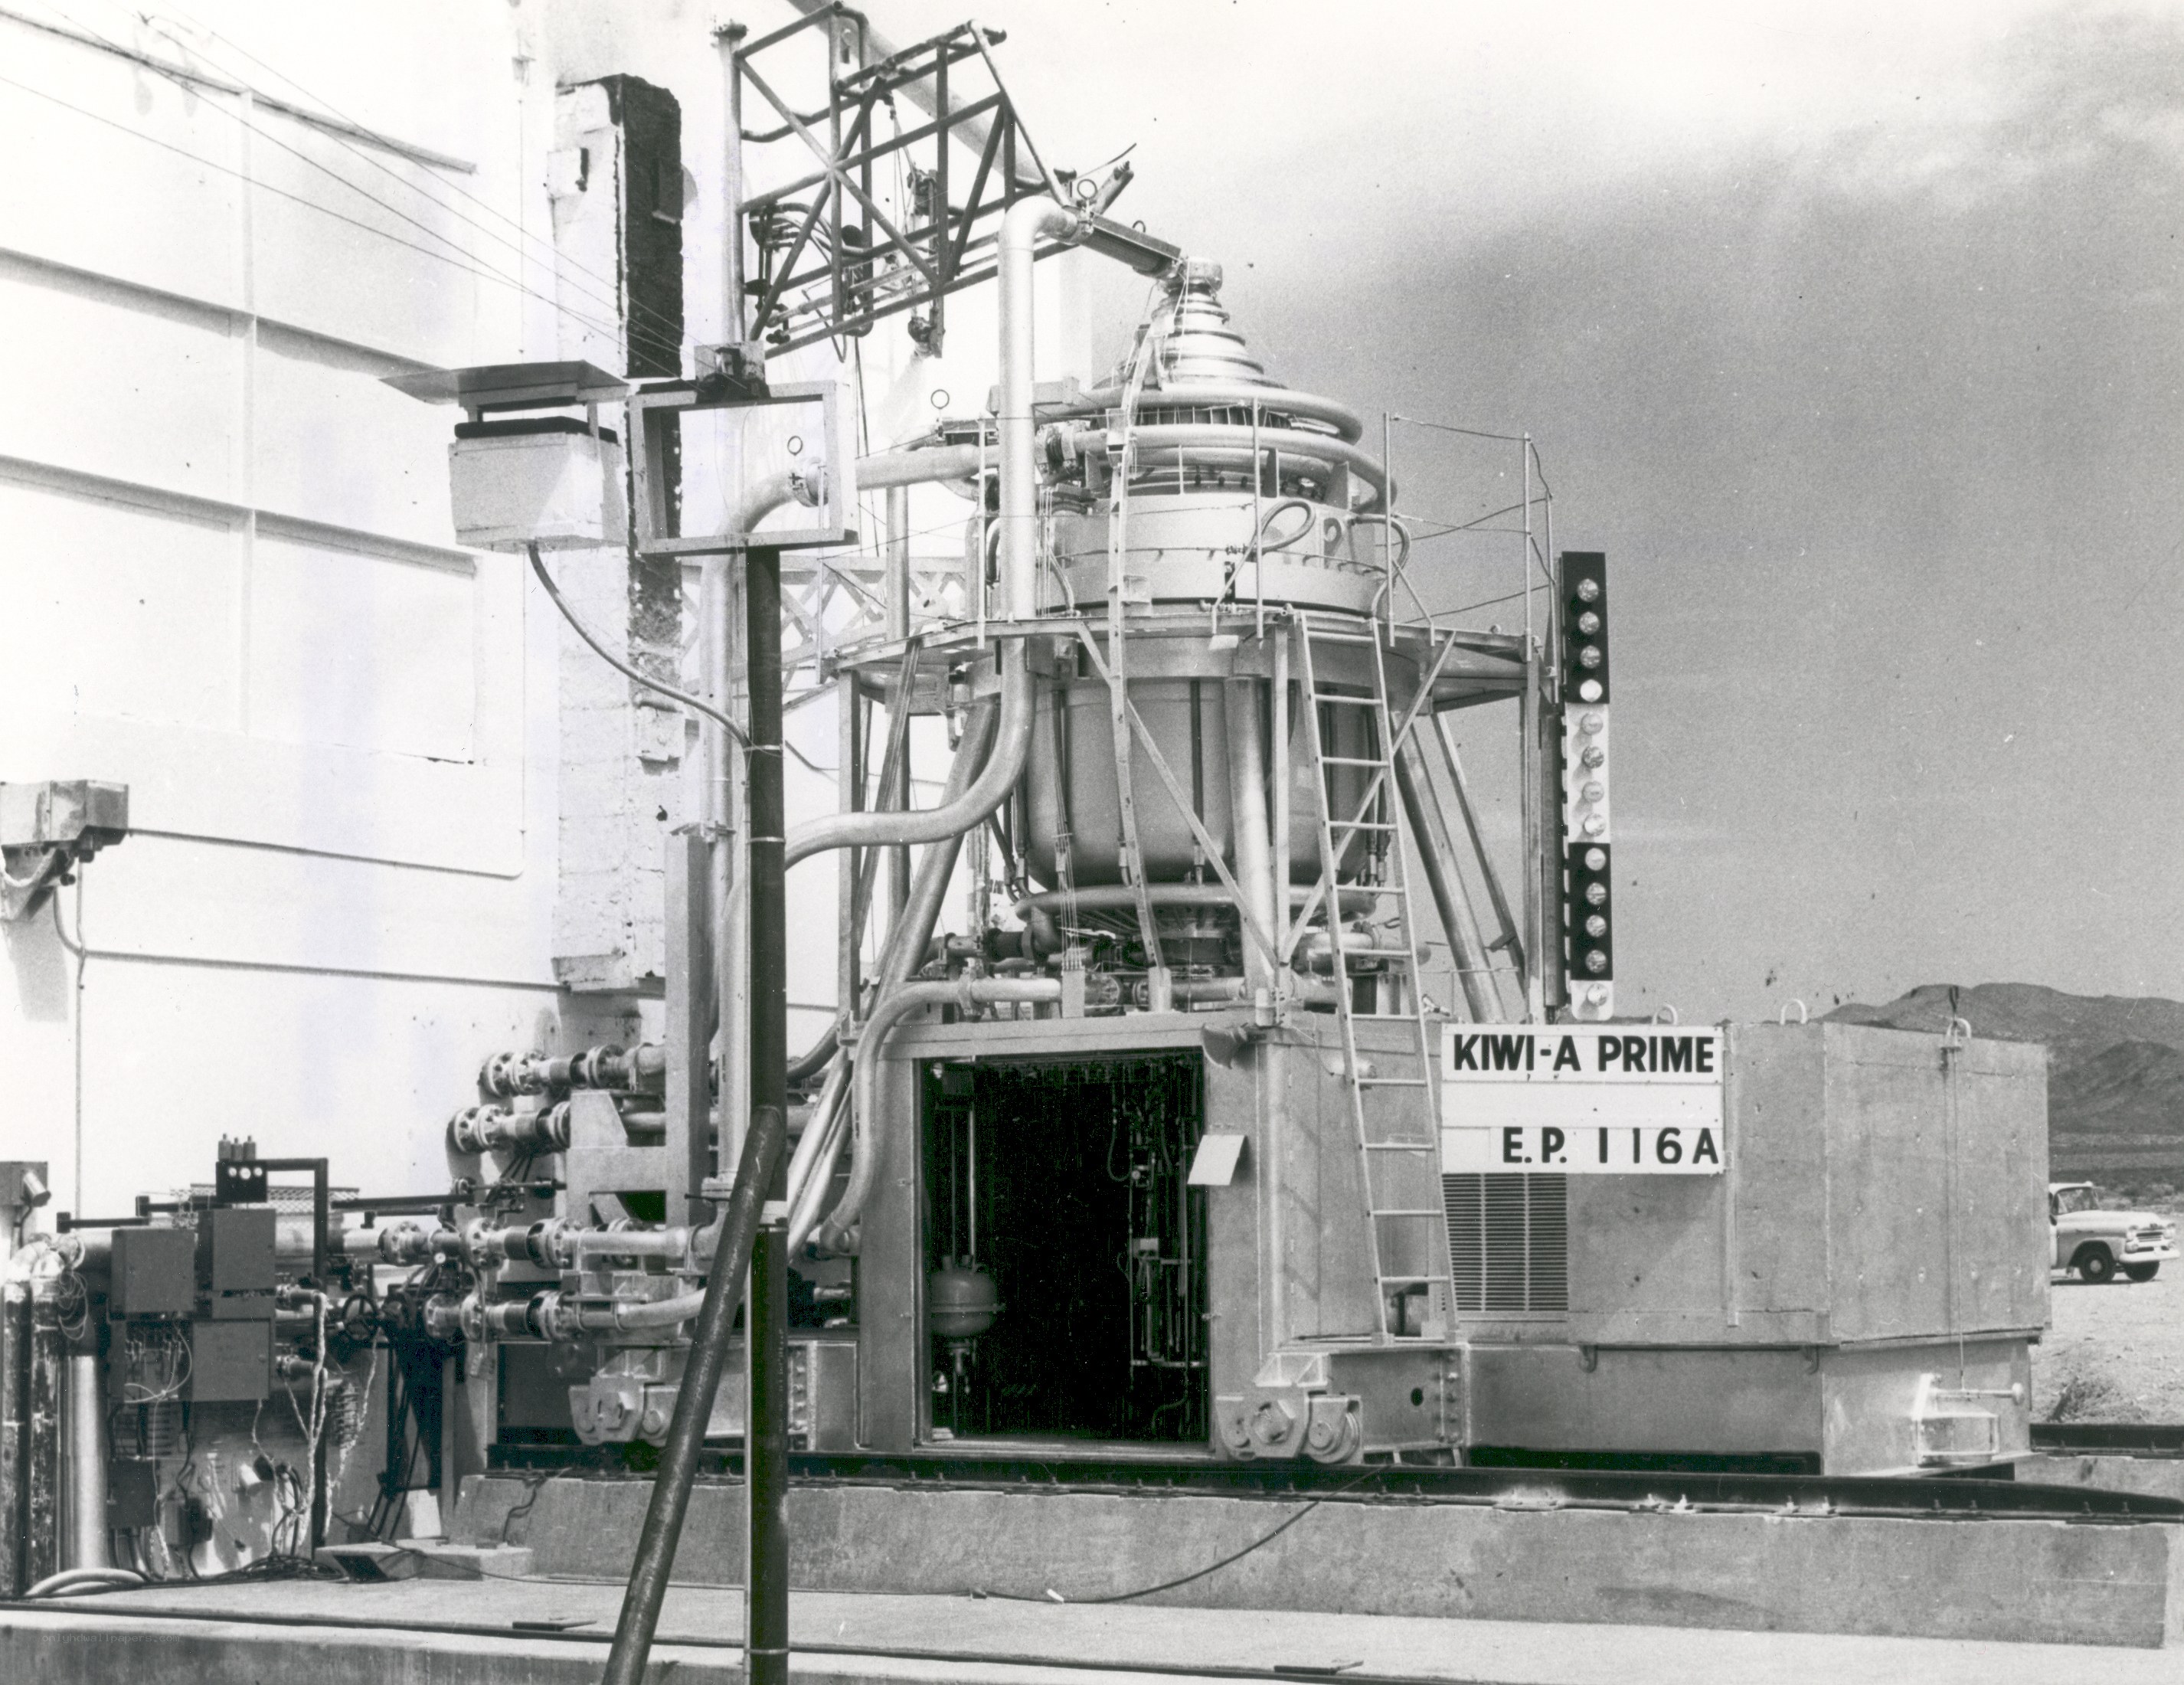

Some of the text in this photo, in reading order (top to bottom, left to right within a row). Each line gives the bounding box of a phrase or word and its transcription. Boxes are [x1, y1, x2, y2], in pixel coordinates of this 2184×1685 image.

[1454, 1034, 1714, 1072] KIWI-A PRIME
[1503, 1127, 1718, 1163] E.P. 116A
